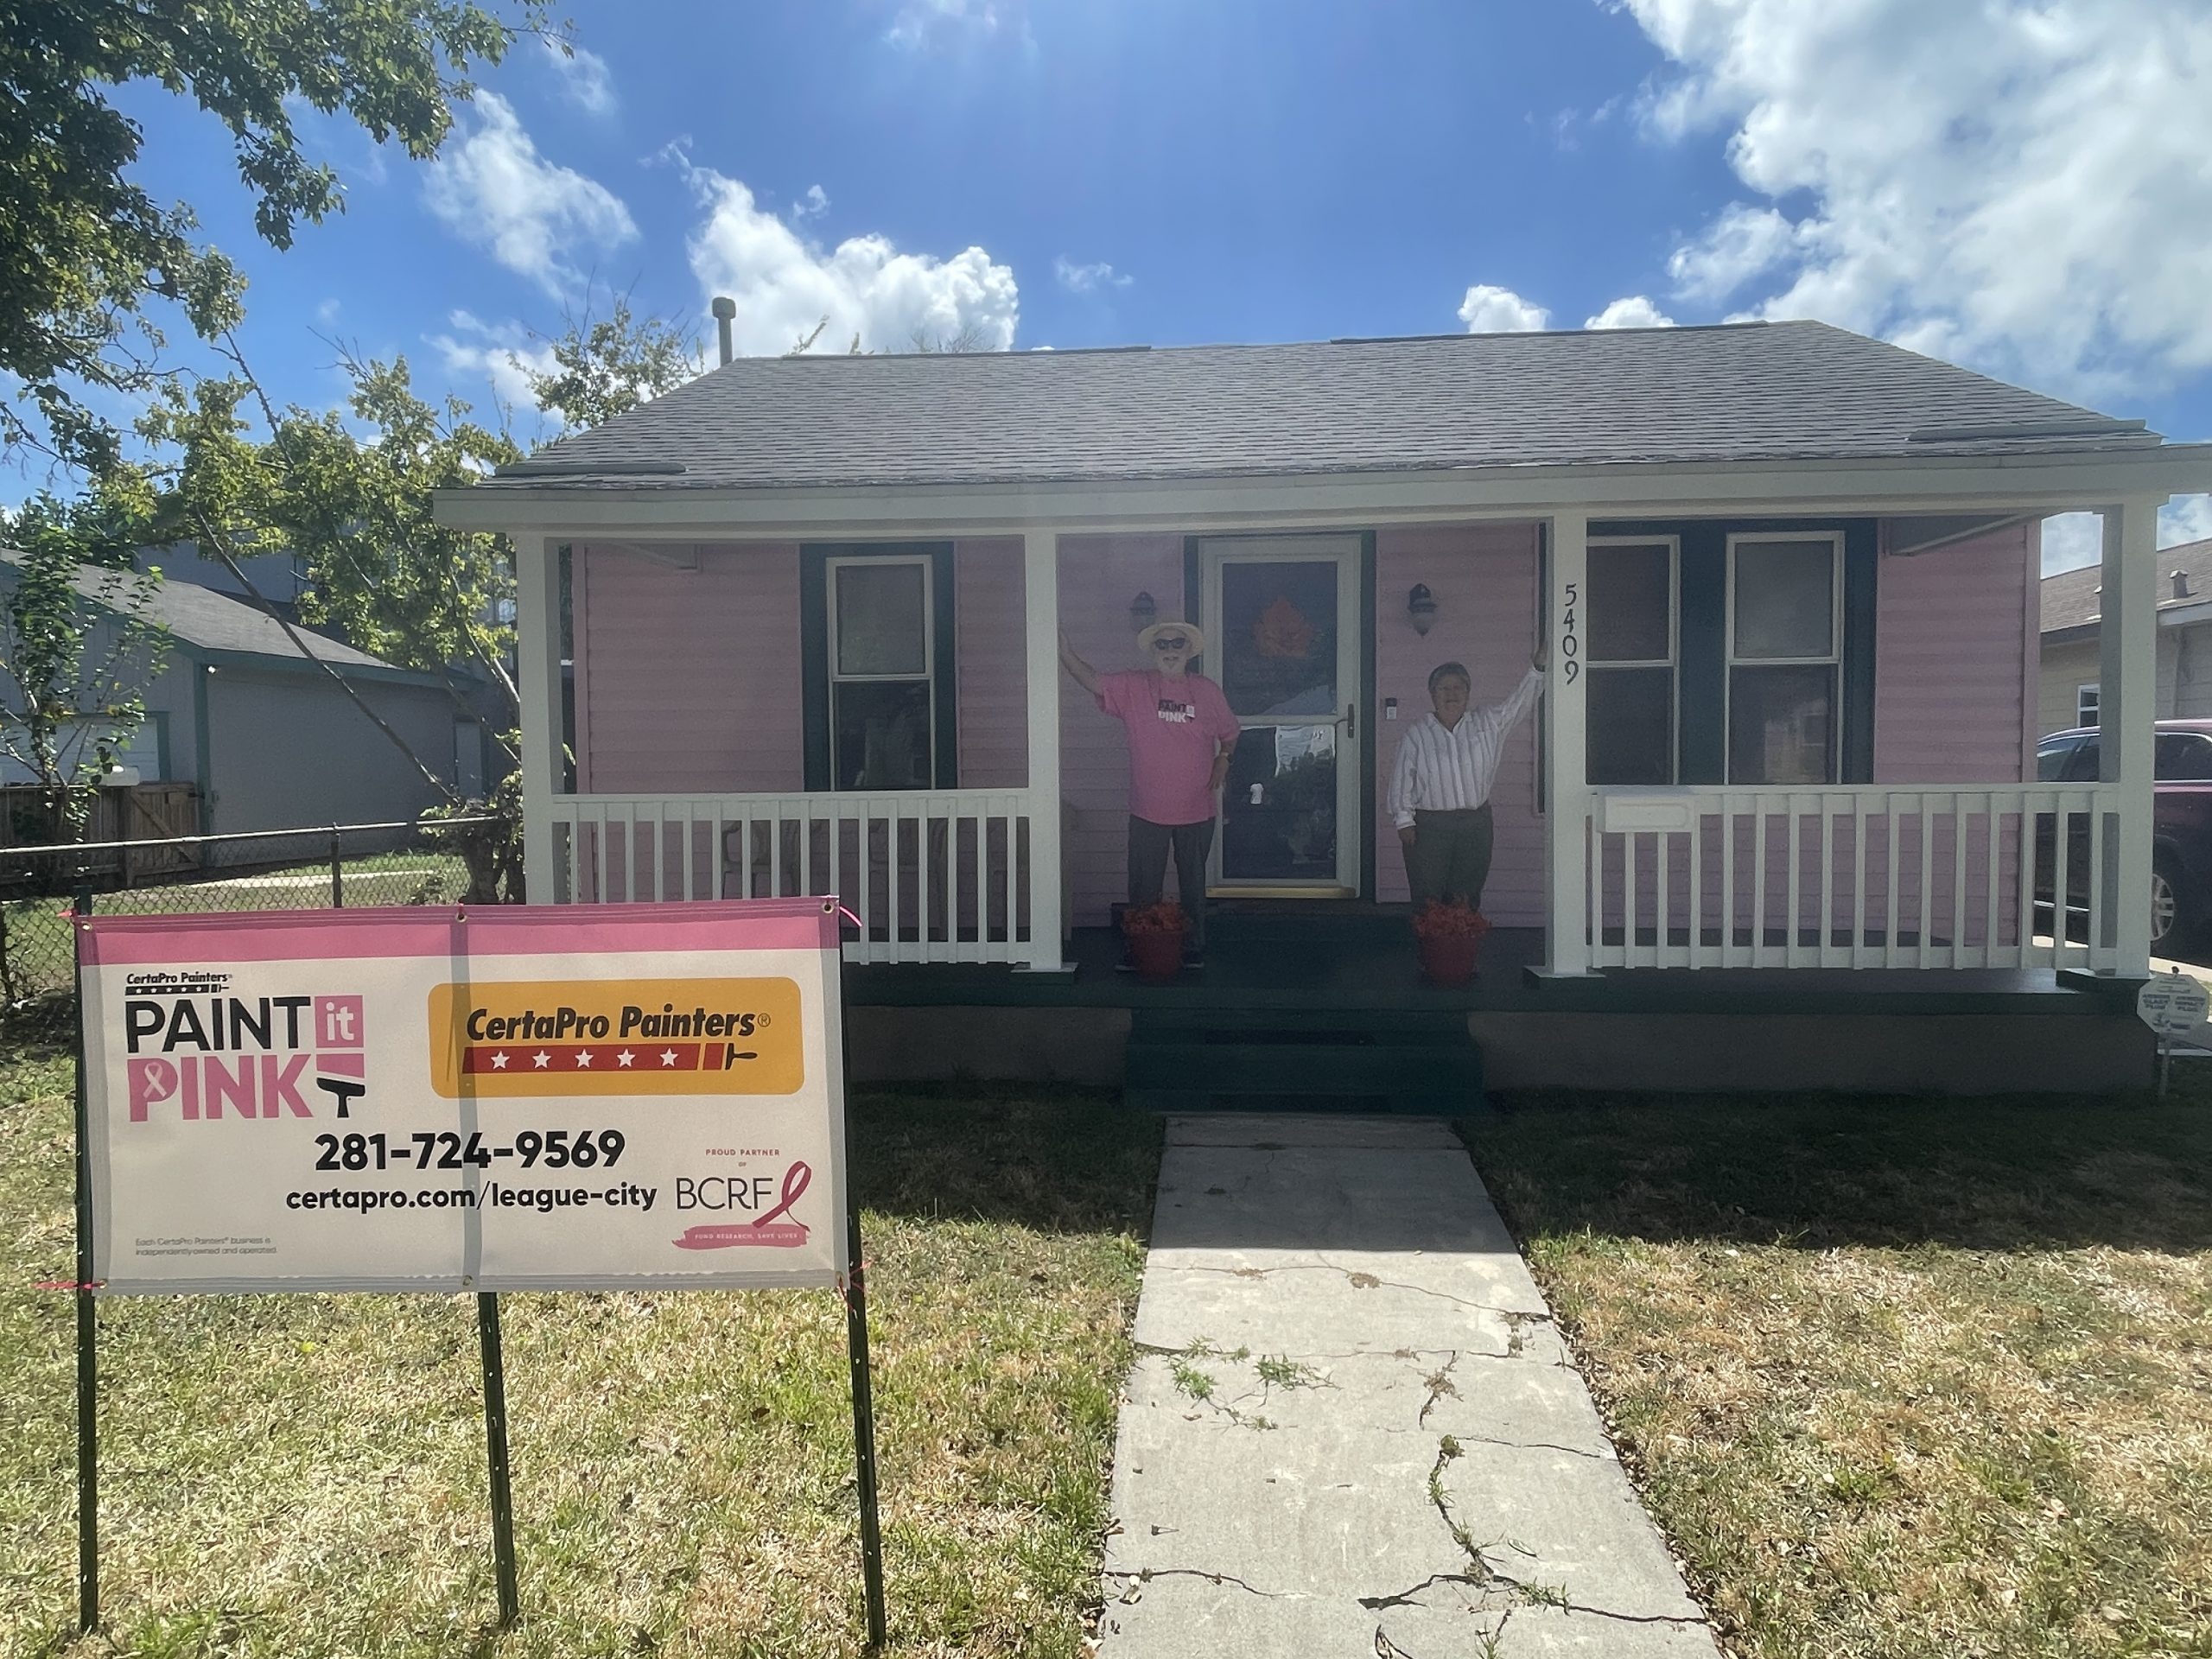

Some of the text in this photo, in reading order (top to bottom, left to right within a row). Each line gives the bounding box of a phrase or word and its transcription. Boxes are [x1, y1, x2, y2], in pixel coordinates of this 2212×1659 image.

[1562, 582, 1579, 685] 5409
[126, 972, 178, 985] CertaPro
[125, 995, 354, 1053] PAINT it
[467, 1007, 610, 1040] CertaPro
[127, 1053, 314, 1122] PINK
[314, 1129, 626, 1171] 281-724-9569
[286, 1180, 658, 1214] certapro.com/league-city
[676, 1177, 773, 1210] BCRF
[135, 1237, 156, 1247] Each
[157, 1237, 194, 1246] CertaPro
